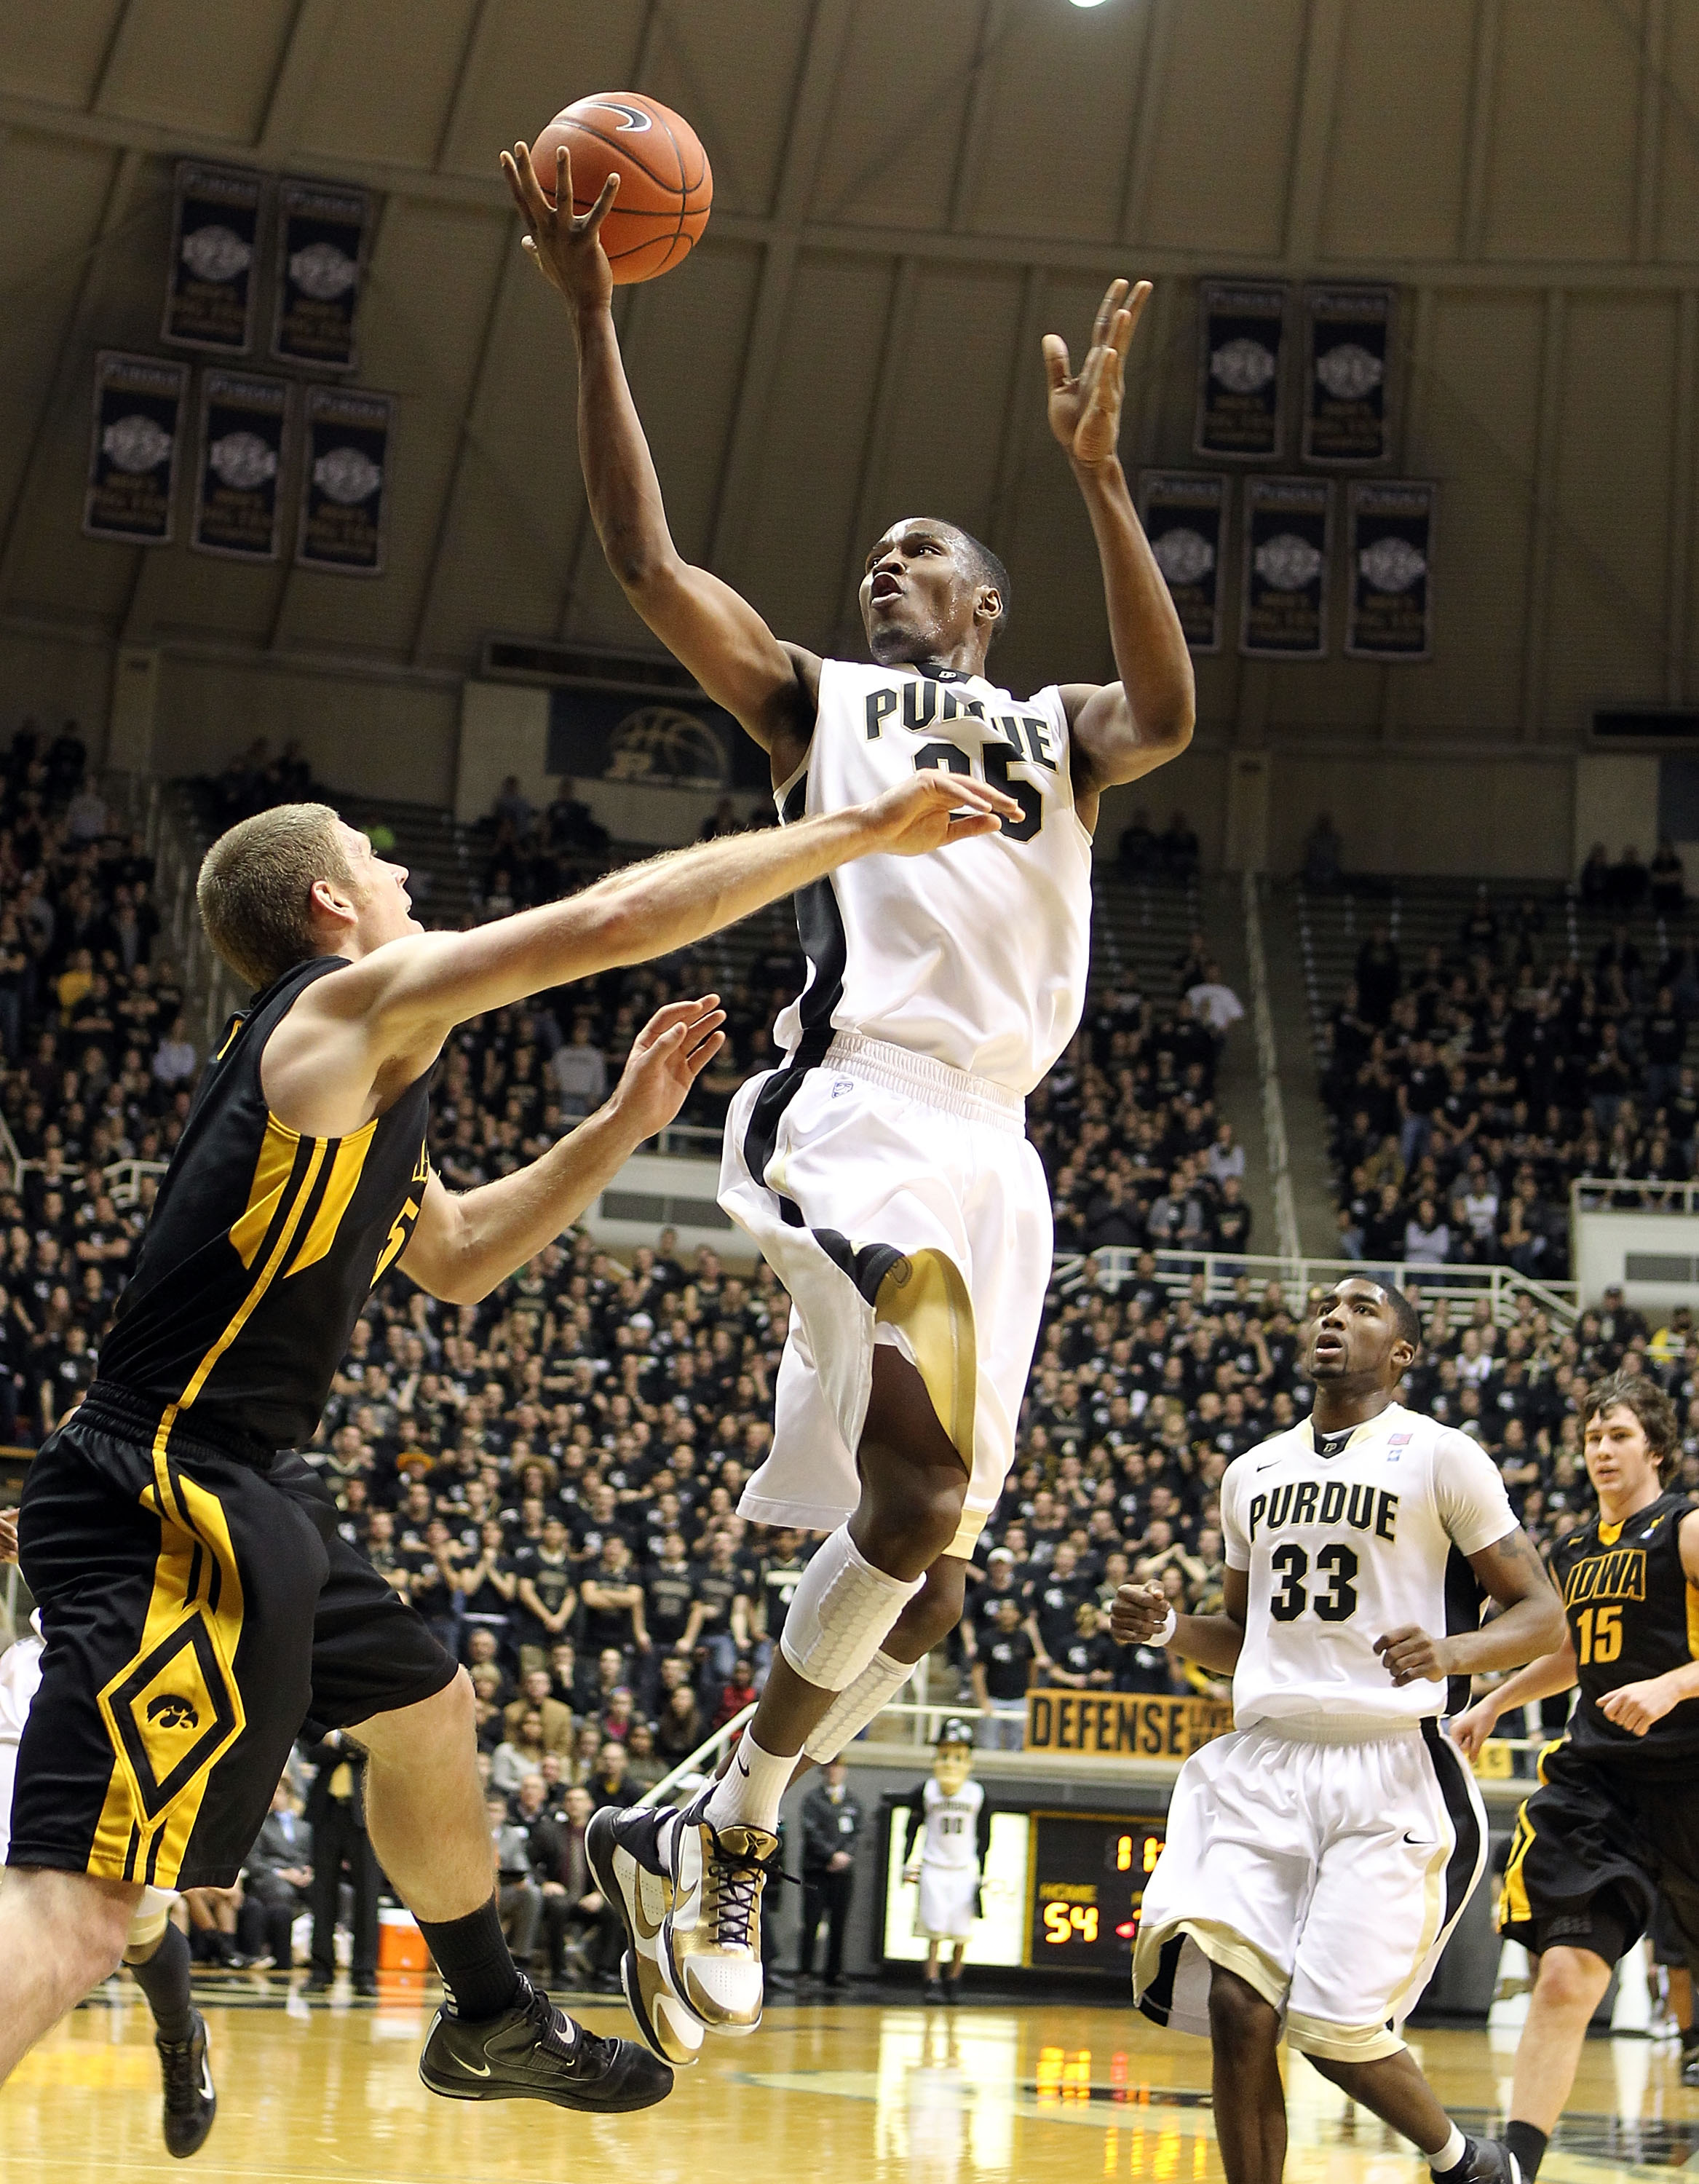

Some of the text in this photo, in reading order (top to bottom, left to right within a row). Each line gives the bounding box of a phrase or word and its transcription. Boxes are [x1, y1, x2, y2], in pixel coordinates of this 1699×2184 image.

[1249, 1481, 1400, 1547] PURDUE
[1270, 1541, 1359, 1624] 33
[1565, 1548, 1647, 1613] IOWA
[1577, 1605, 1623, 1666] 15
[1032, 1697, 1183, 1754] DEFENSE
[1043, 1901, 1099, 1944] 54
